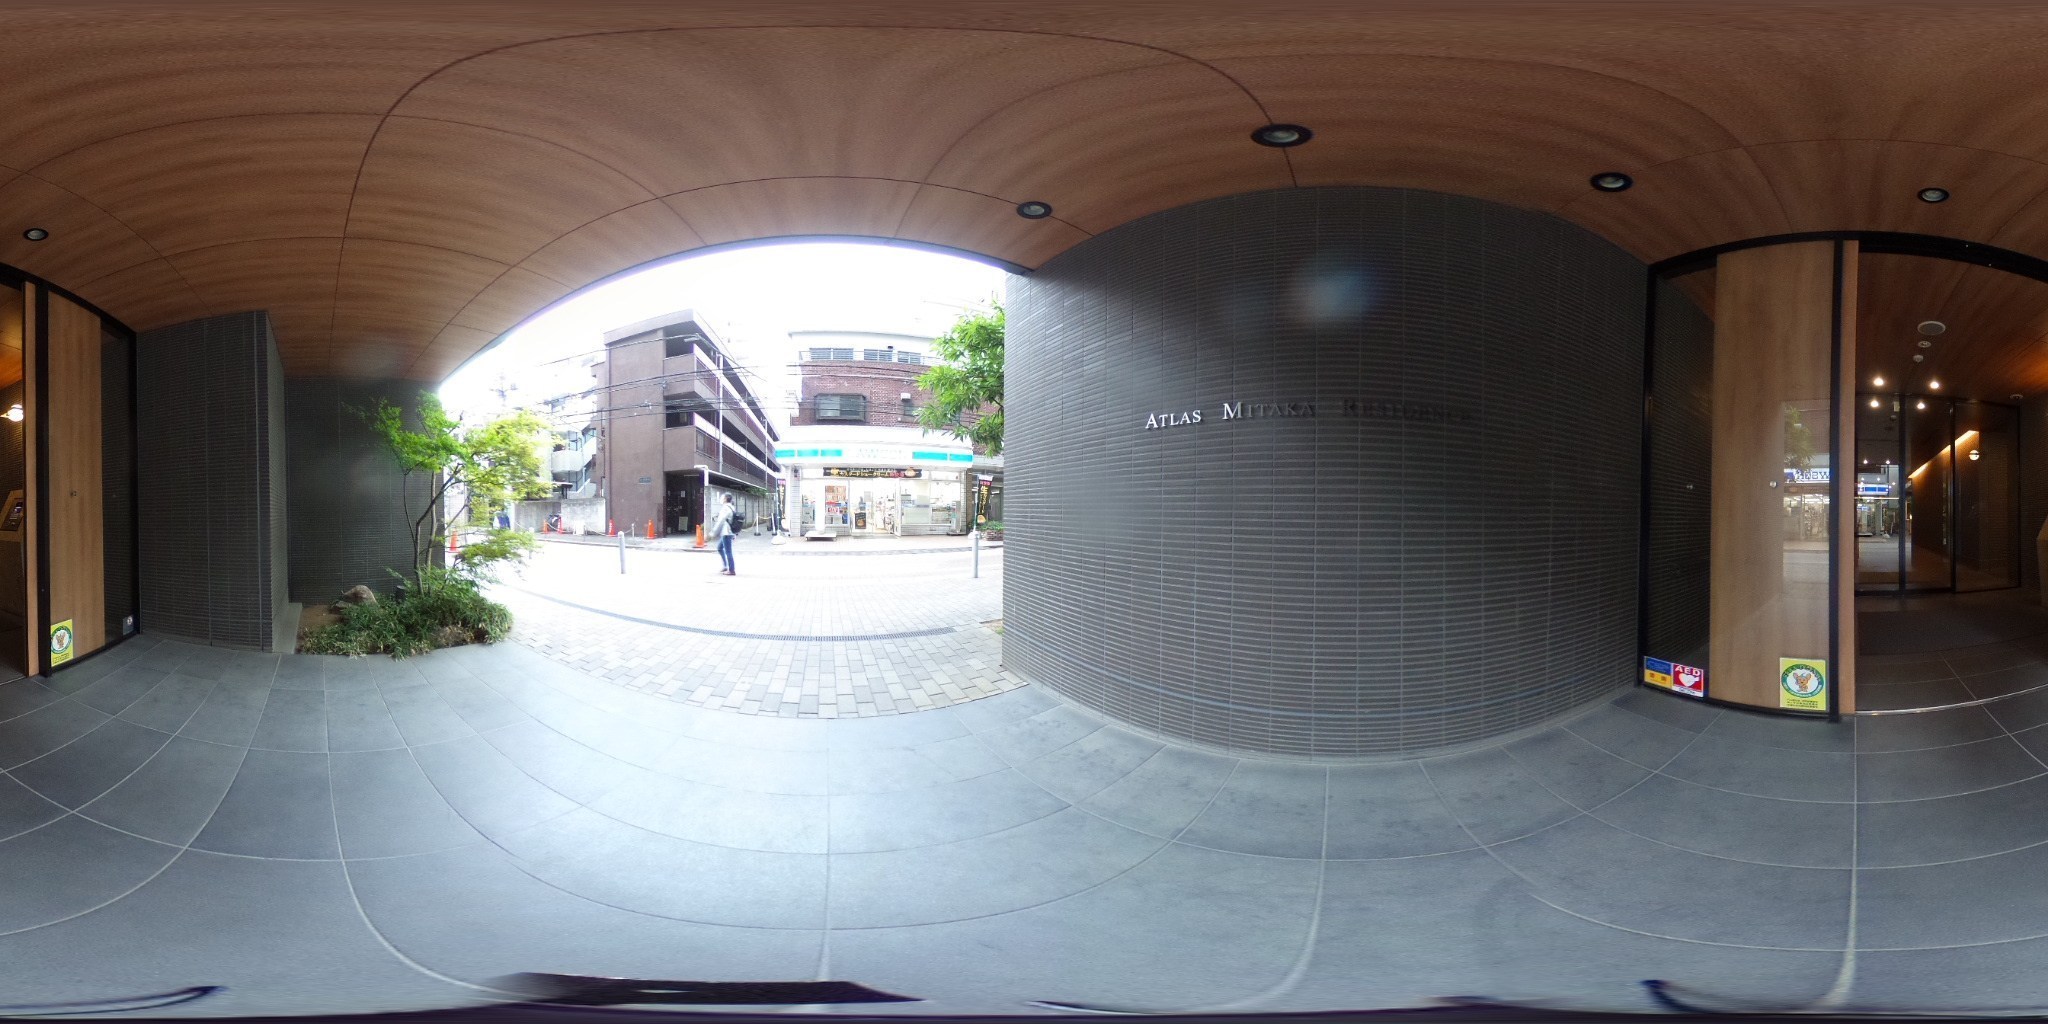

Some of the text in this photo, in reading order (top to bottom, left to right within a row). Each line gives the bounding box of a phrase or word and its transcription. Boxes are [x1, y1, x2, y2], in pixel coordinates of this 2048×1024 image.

[1145, 409, 1202, 429] ATLAS
[1222, 401, 1314, 420] MITAKA
[1674, 665, 1701, 677] AED
